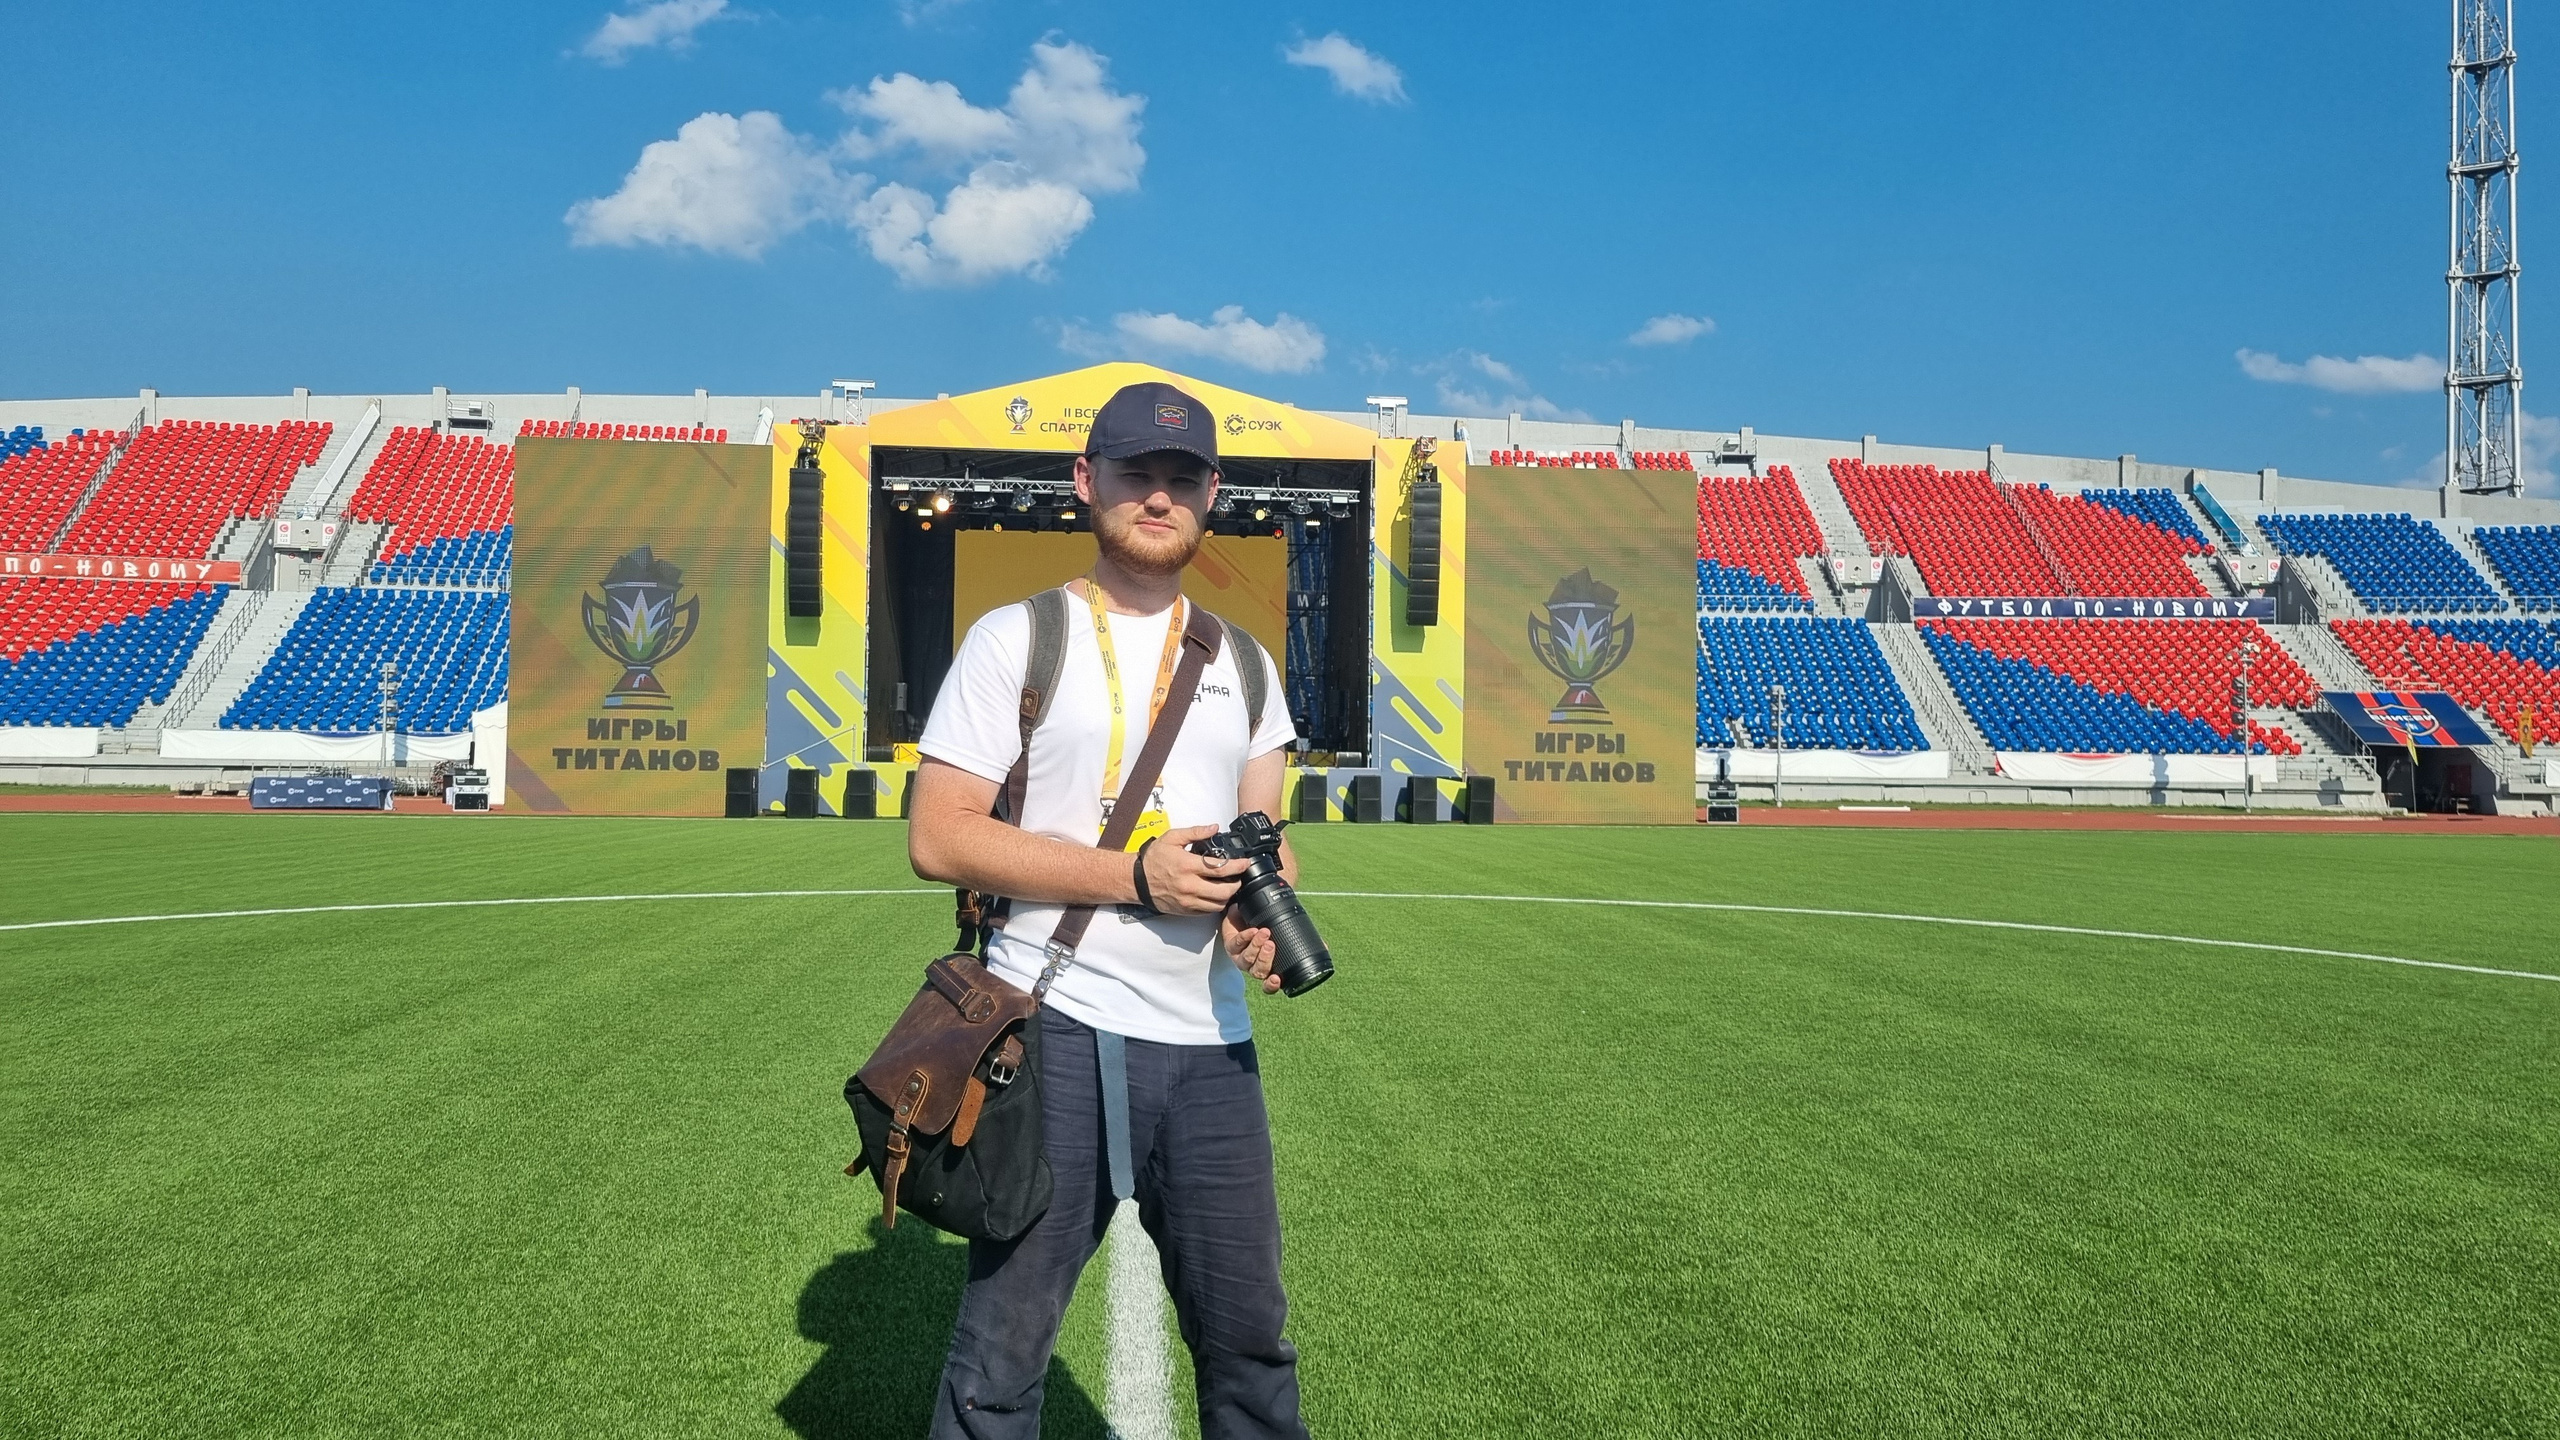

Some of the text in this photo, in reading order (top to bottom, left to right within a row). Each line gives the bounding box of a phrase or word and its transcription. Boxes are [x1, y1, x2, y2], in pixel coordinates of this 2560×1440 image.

[1064, 408, 1071, 418] II
[1248, 420, 1282, 431] СУЭК
[4, 556, 213, 580] ПО-НОВОМУ
[1937, 598, 2249, 618] ФУТБОЛ ПО-НОВОМУ
[1197, 683, 1230, 698] НАЯ
[587, 718, 687, 742] ИГРЫ
[1535, 732, 1625, 754] ИГРЫ
[552, 748, 720, 772] ТИТАНОВ
[1504, 760, 1656, 783] ТИТАНОВ
